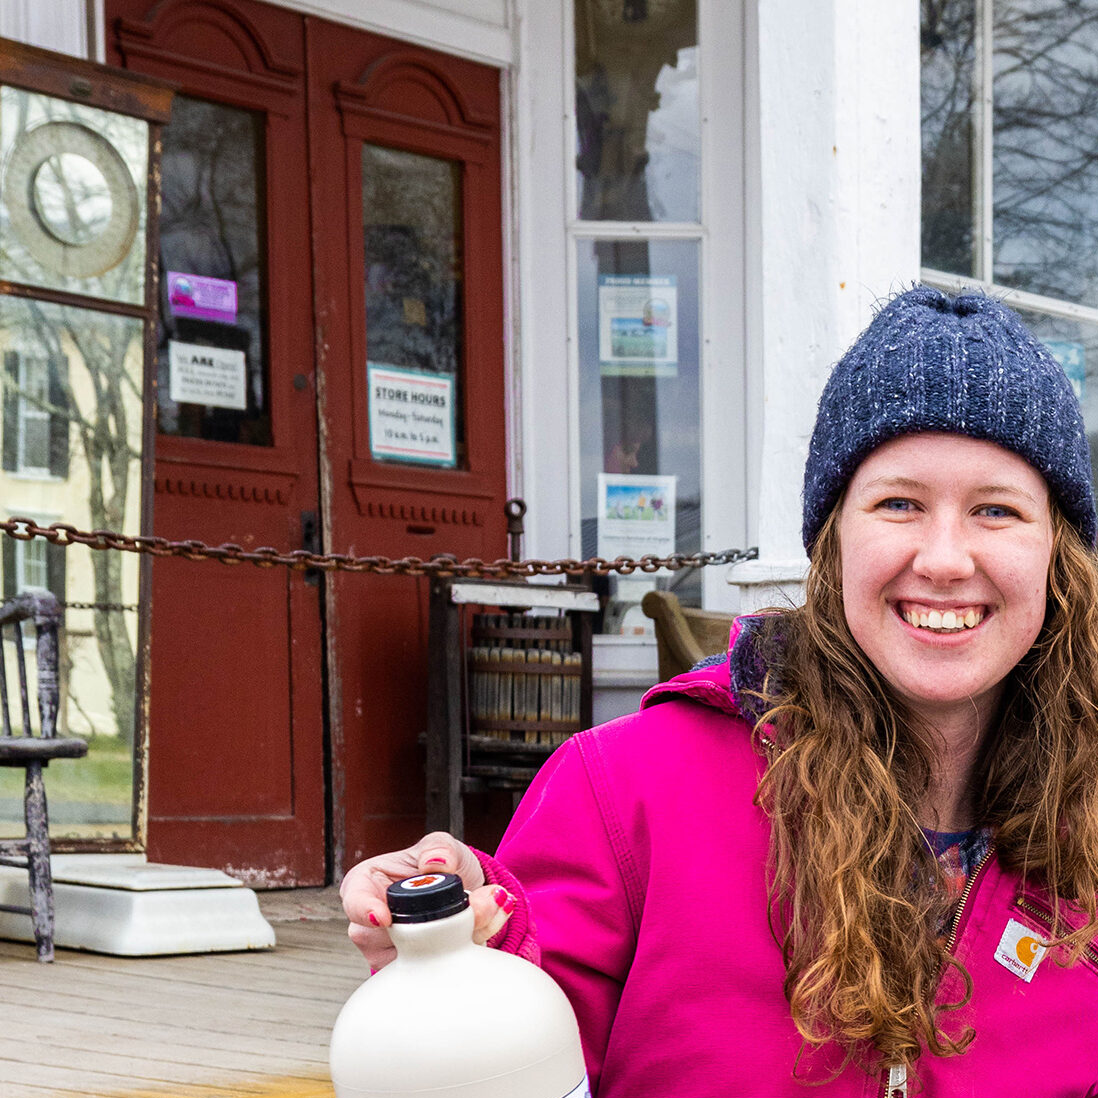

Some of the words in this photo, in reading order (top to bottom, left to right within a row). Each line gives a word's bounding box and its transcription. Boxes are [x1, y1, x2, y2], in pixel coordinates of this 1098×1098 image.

[191, 354, 214, 367] ARE
[375, 386, 408, 402] STORE
[411, 391, 446, 407] HOURS
